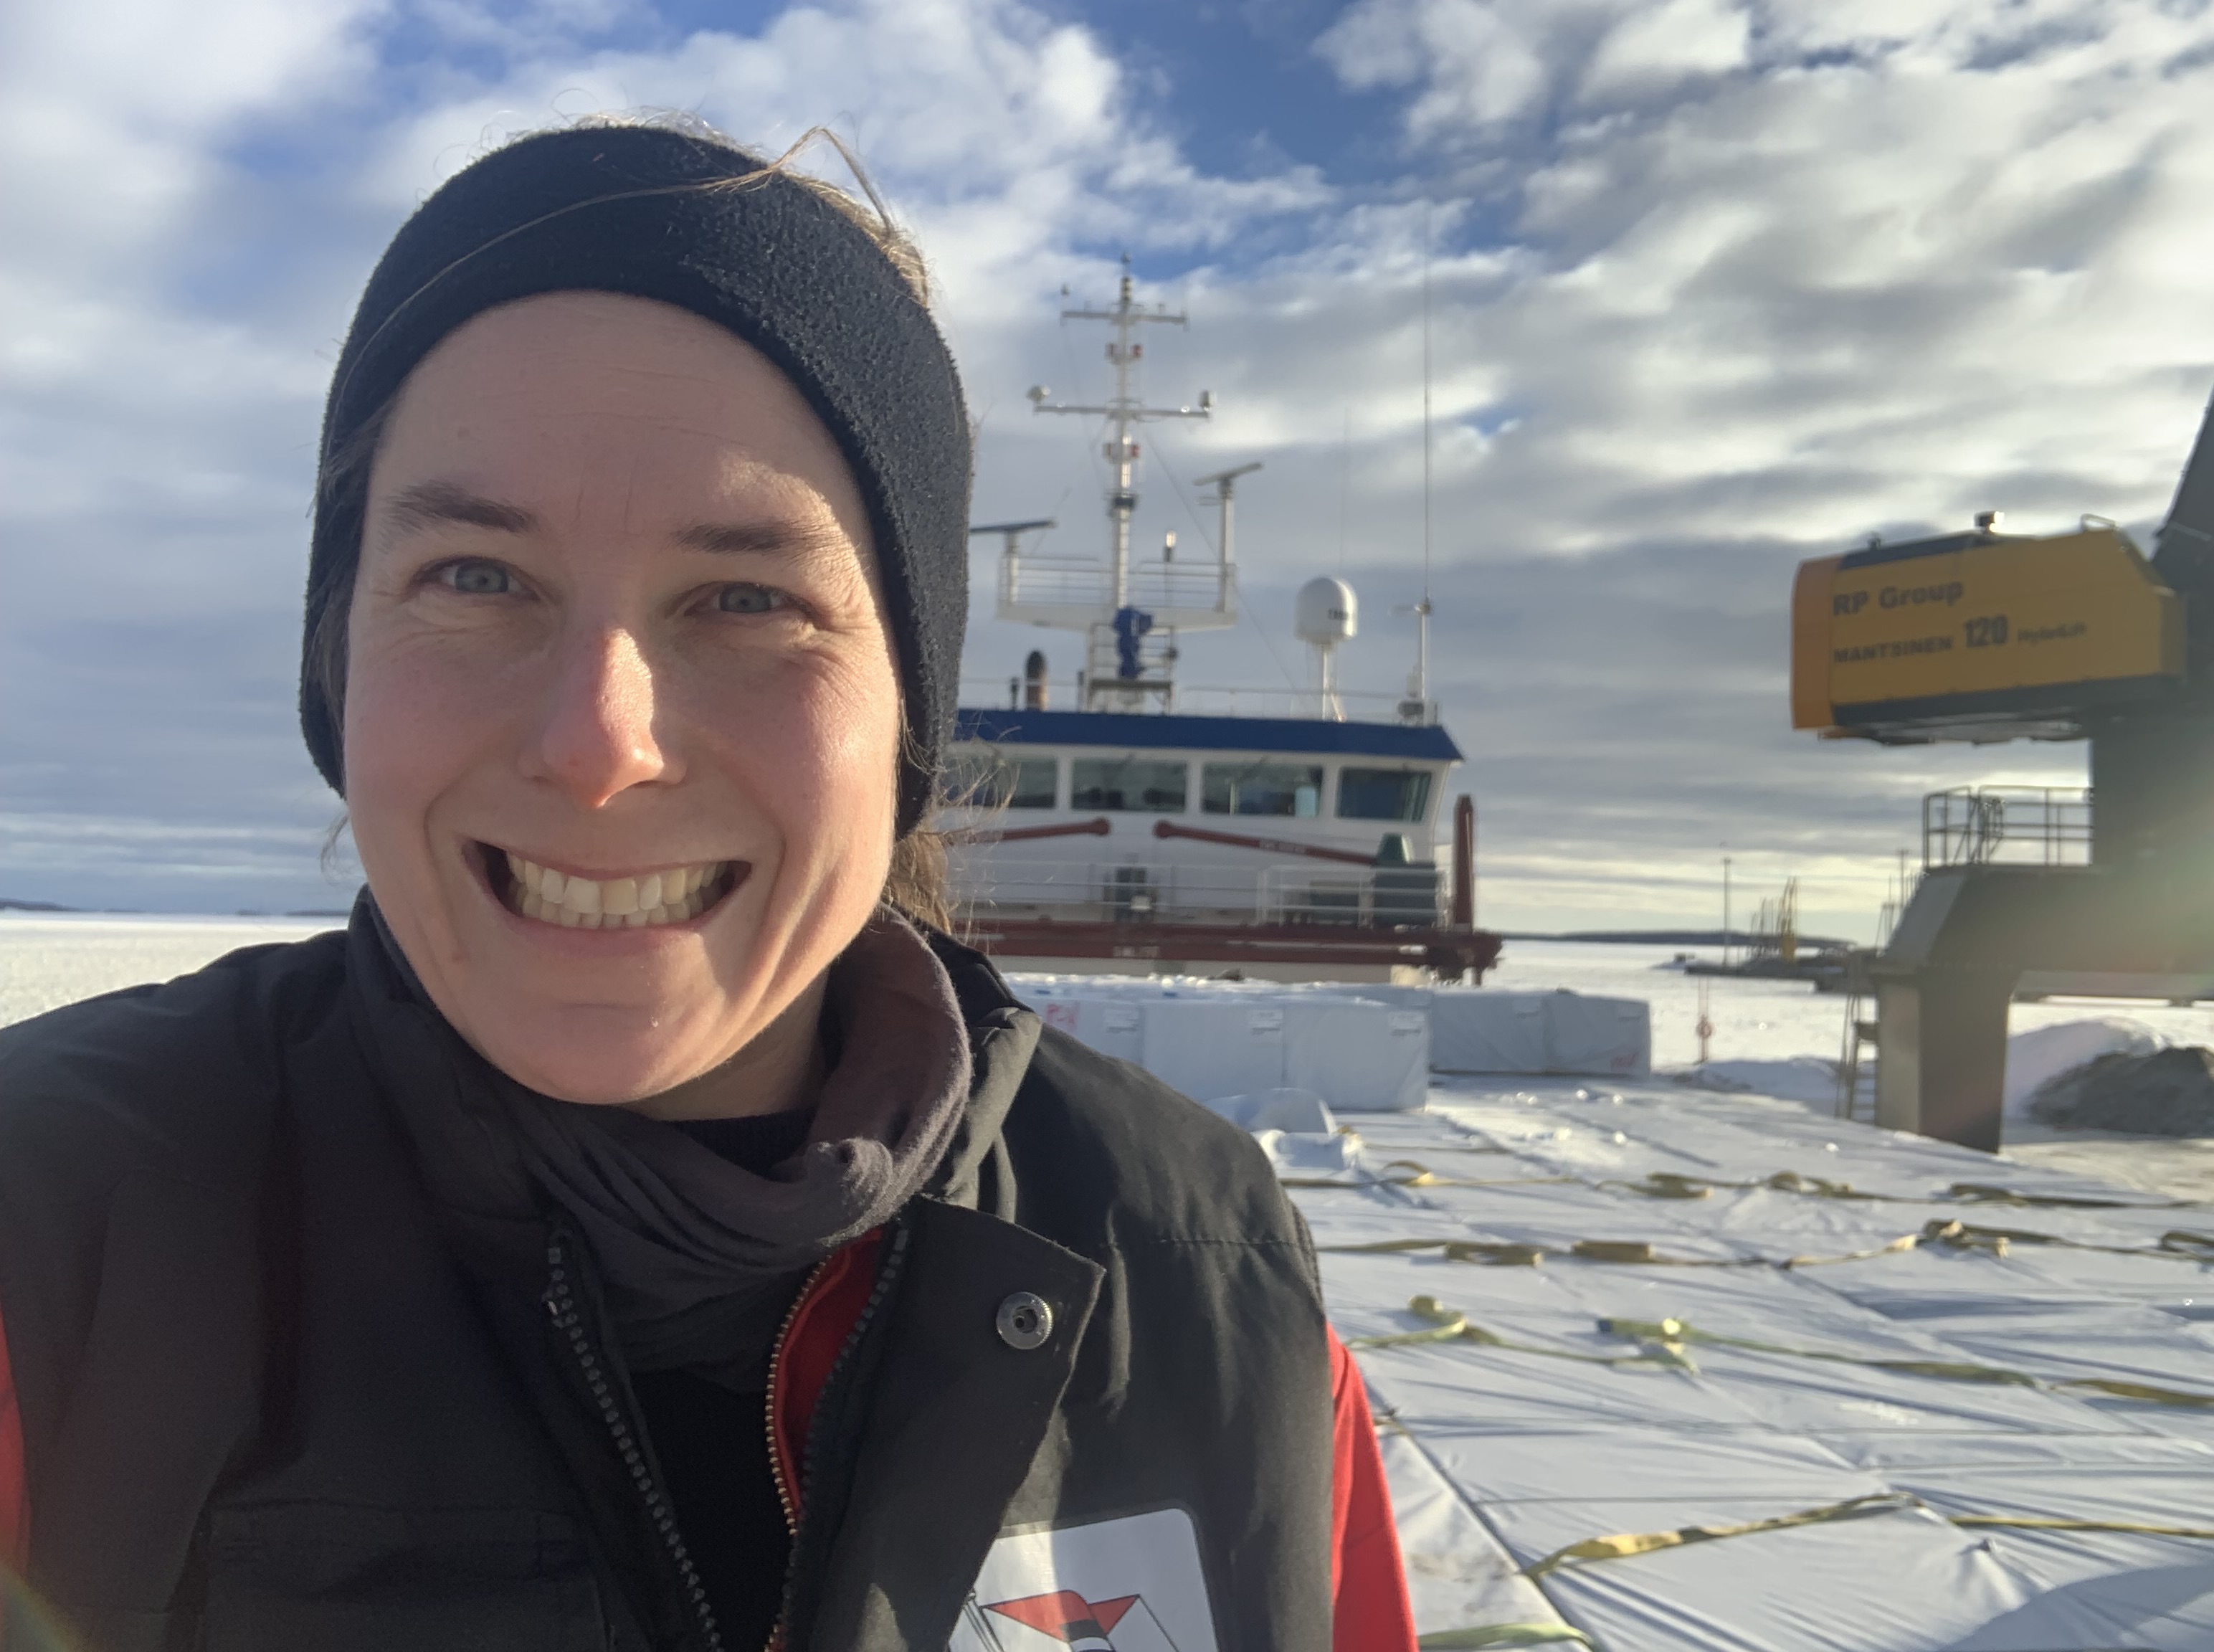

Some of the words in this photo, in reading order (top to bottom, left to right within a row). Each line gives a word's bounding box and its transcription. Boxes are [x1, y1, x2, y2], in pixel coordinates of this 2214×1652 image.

[1833, 589, 1870, 616] RP
[1878, 581, 1964, 609] Group
[1833, 635, 1953, 663] MANTSINEN
[1964, 614, 2008, 648] 120
